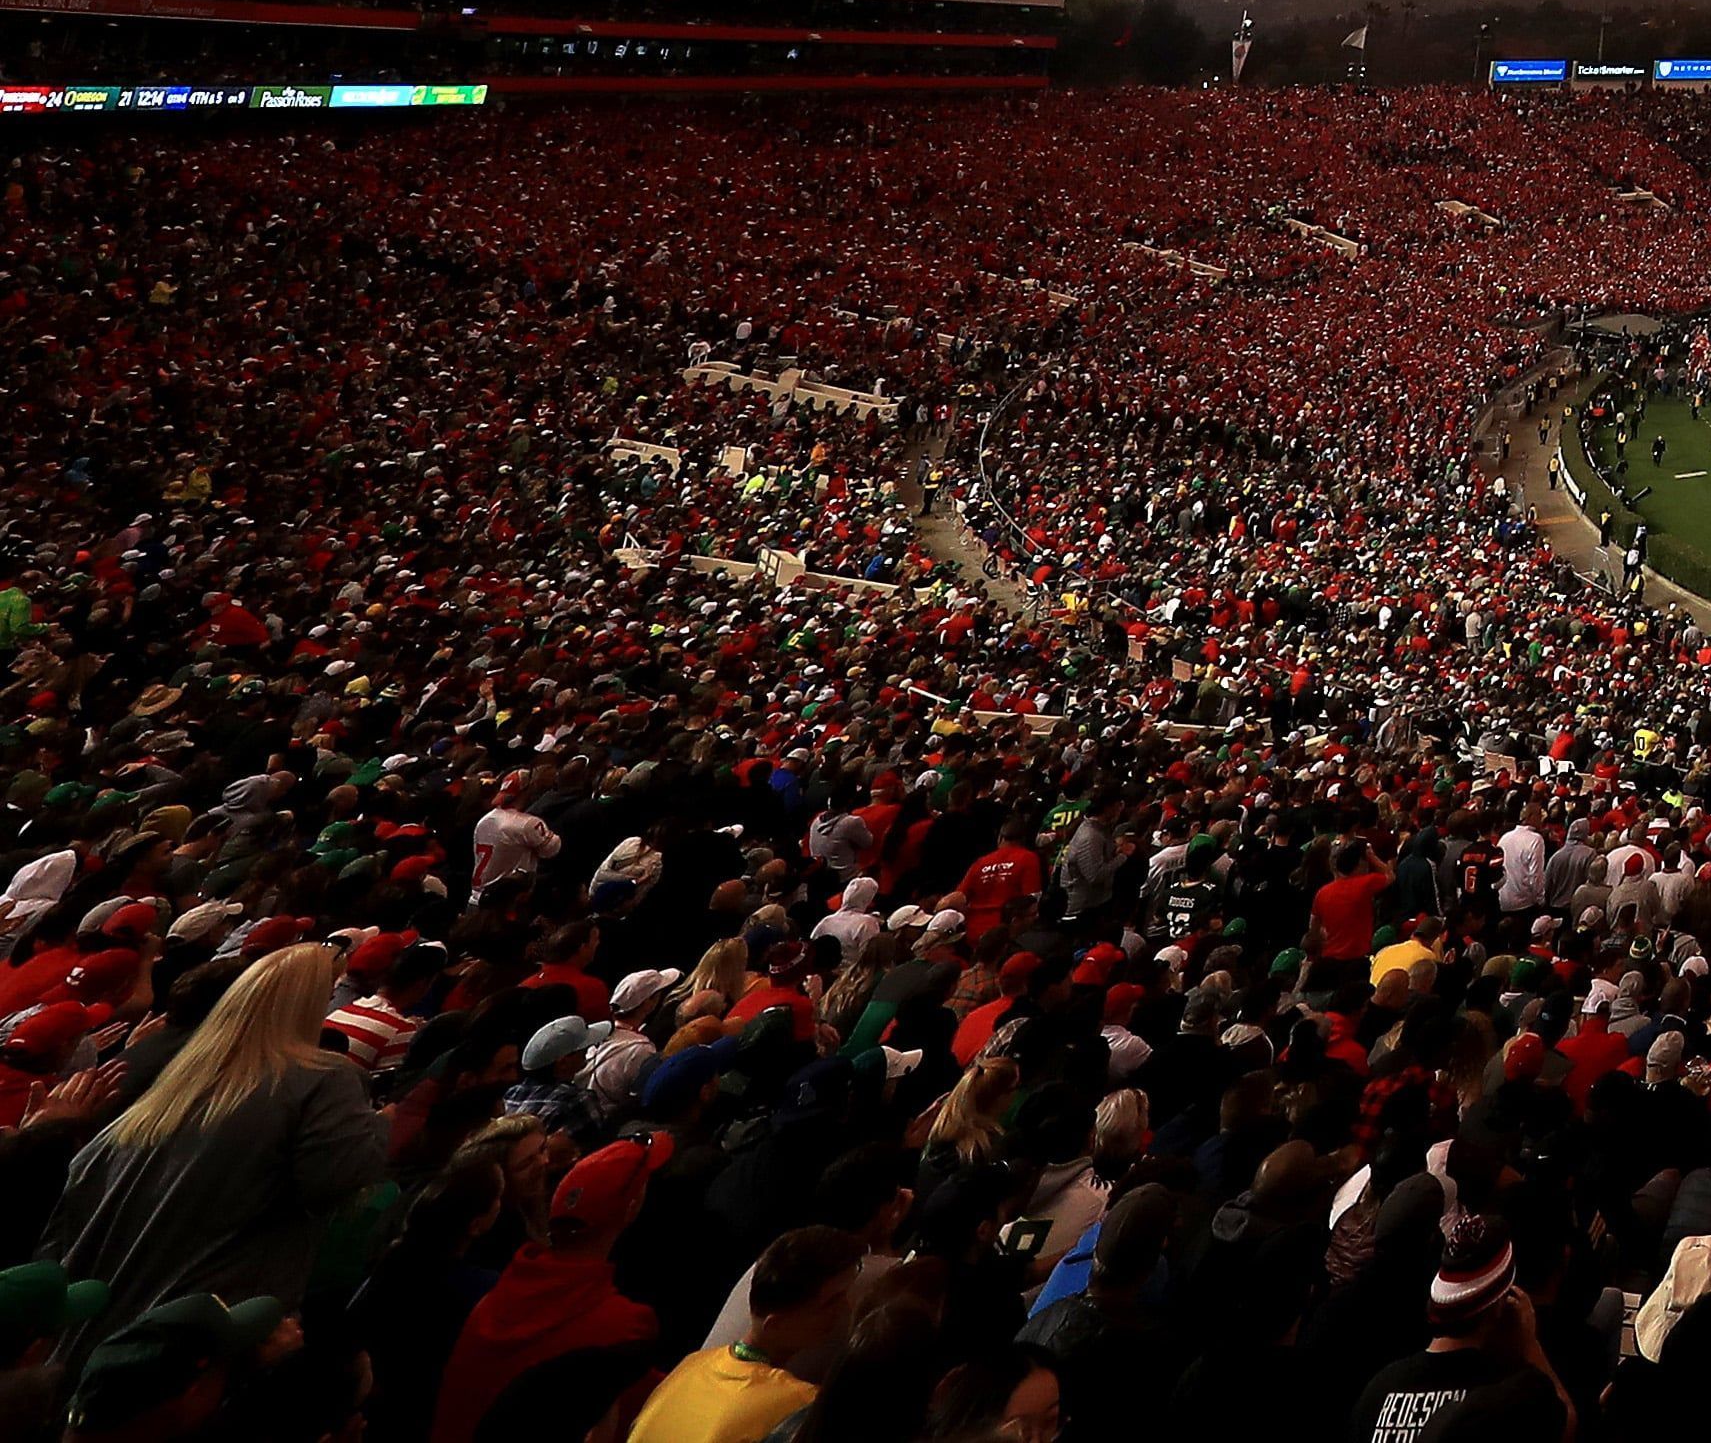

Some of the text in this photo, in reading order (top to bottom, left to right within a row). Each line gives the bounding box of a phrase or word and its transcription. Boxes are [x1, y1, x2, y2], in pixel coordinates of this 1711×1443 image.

[46, 91, 62, 107] 24
[76, 92, 108, 103] OREGON
[118, 91, 133, 106] 21
[473, 843, 493, 887] 7
[1460, 864, 1476, 895] 6
